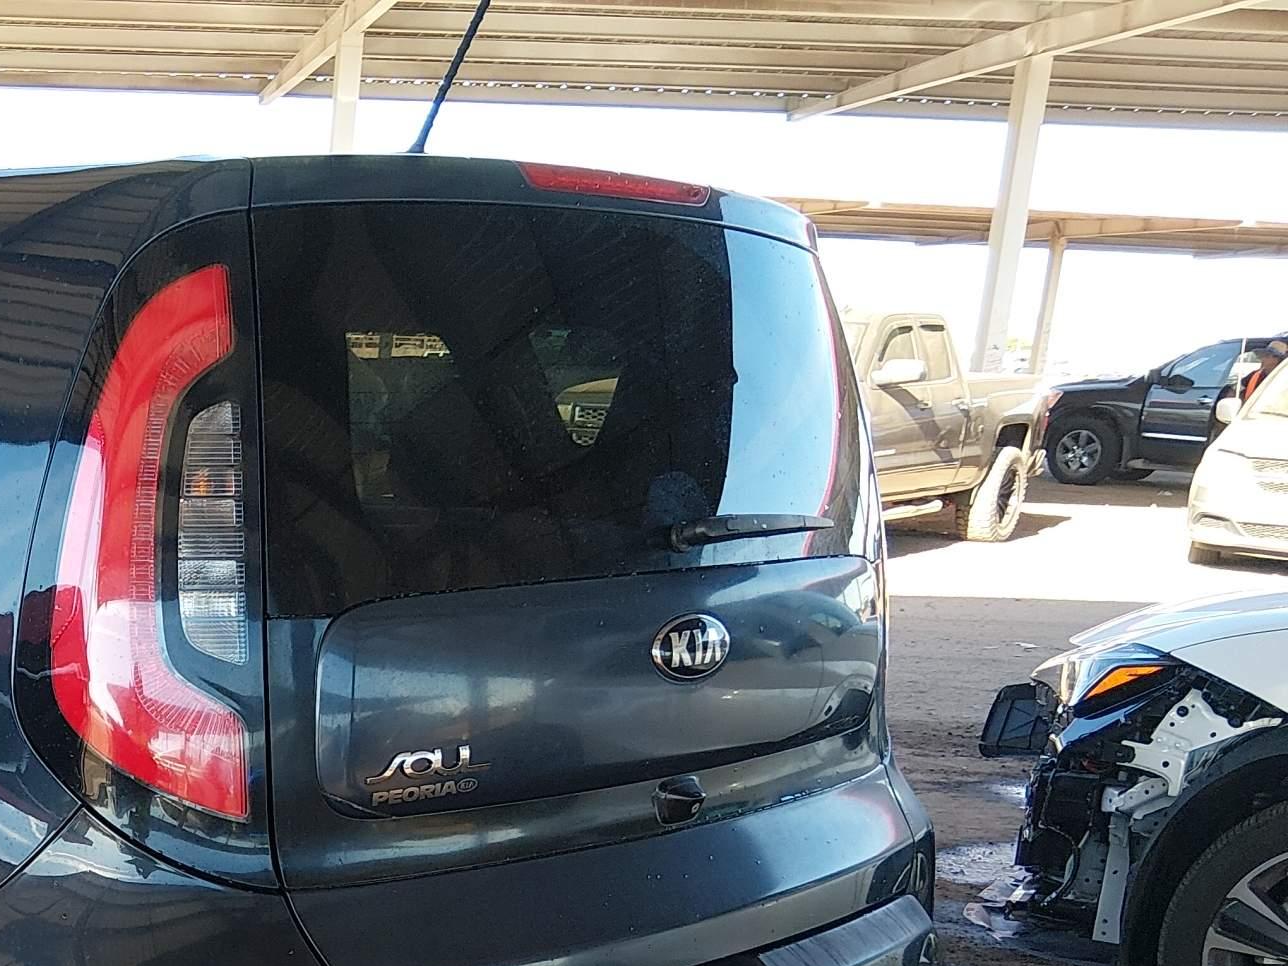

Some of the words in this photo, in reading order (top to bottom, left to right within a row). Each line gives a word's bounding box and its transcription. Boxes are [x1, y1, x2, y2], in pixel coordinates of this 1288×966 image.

[668, 628, 722, 668] KIA
[365, 745, 491, 785] SOUL
[372, 780, 457, 807] PEORIA
